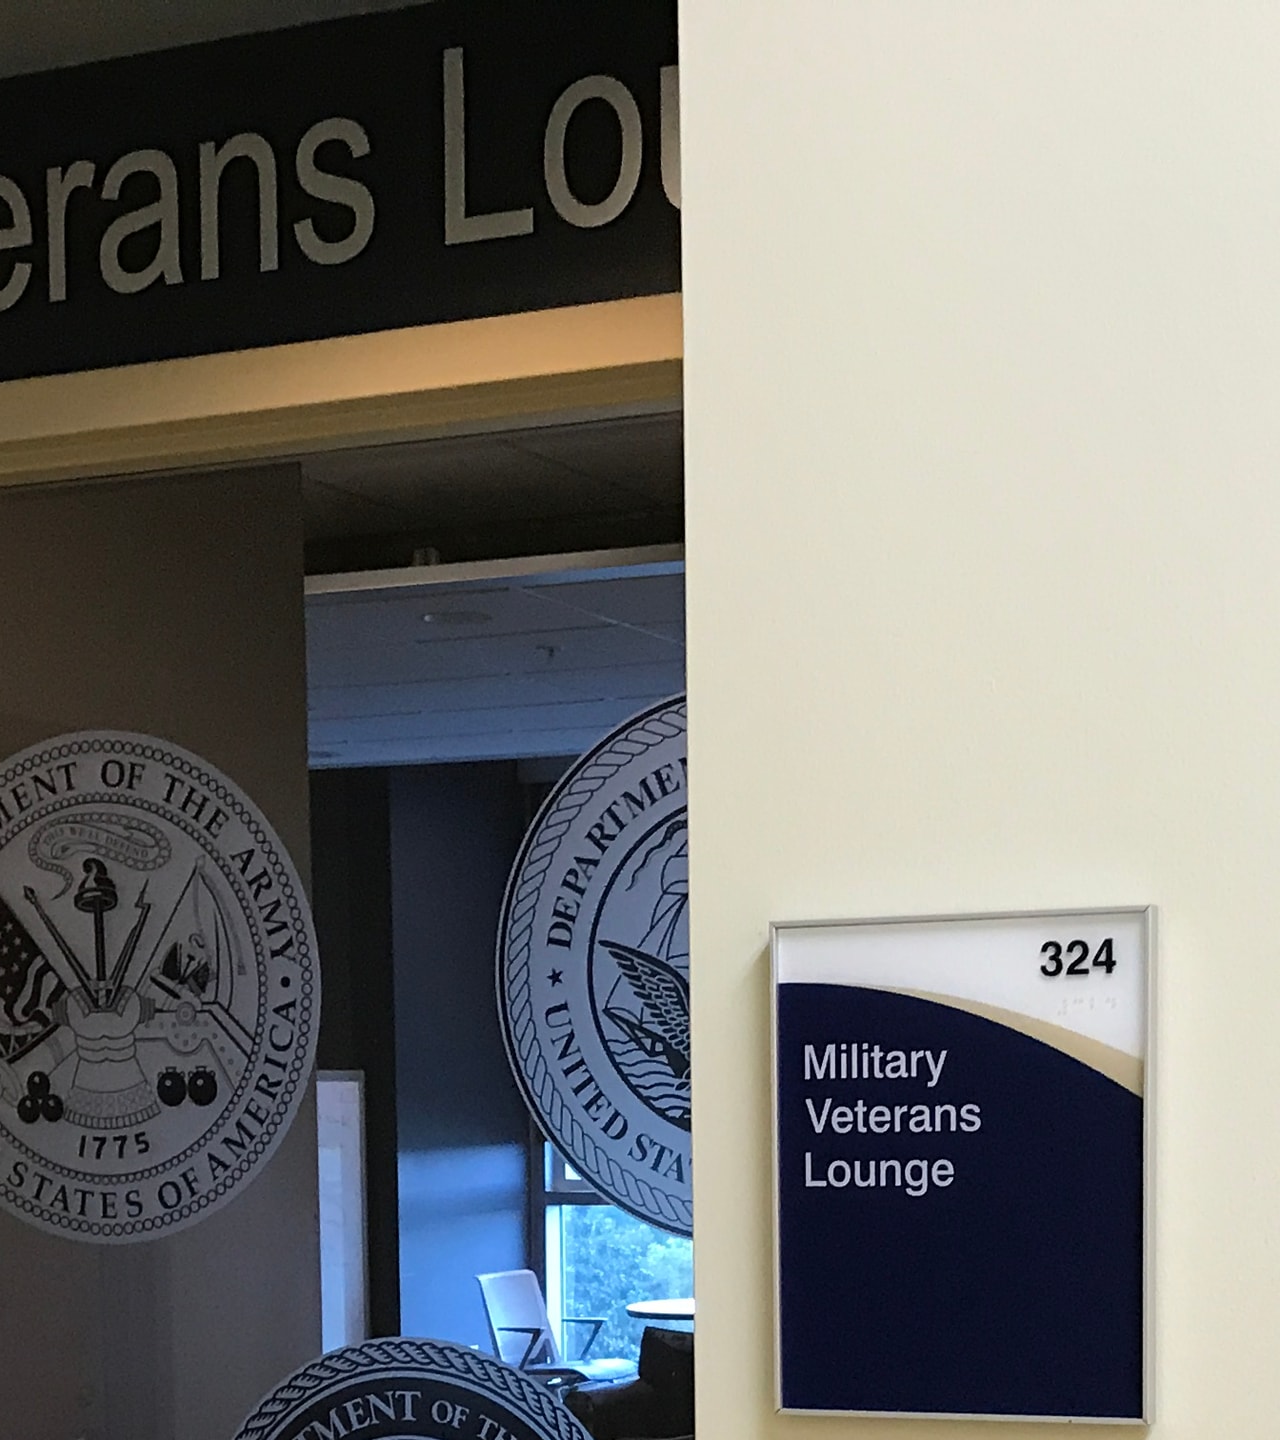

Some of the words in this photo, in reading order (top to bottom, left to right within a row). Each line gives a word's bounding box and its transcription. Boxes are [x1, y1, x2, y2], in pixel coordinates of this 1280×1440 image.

[442, 46, 679, 246] Lo
[100, 759, 146, 791] OF
[164, 773, 229, 838] THE
[230, 846, 301, 964] ARMY
[1040, 938, 1117, 977] 324
[803, 1042, 947, 1088] Military
[6, 1161, 144, 1220] STATES
[157, 1174, 202, 1211] OF
[206, 999, 298, 1195] AMERICA
[545, 1001, 629, 1142] UNITED
[627, 1133, 692, 1184] STA
[805, 1097, 981, 1134] Veterans
[79, 1132, 150, 1160] 1775
[804, 1152, 955, 1197] Lounge
[431, 1400, 470, 1428] OF
